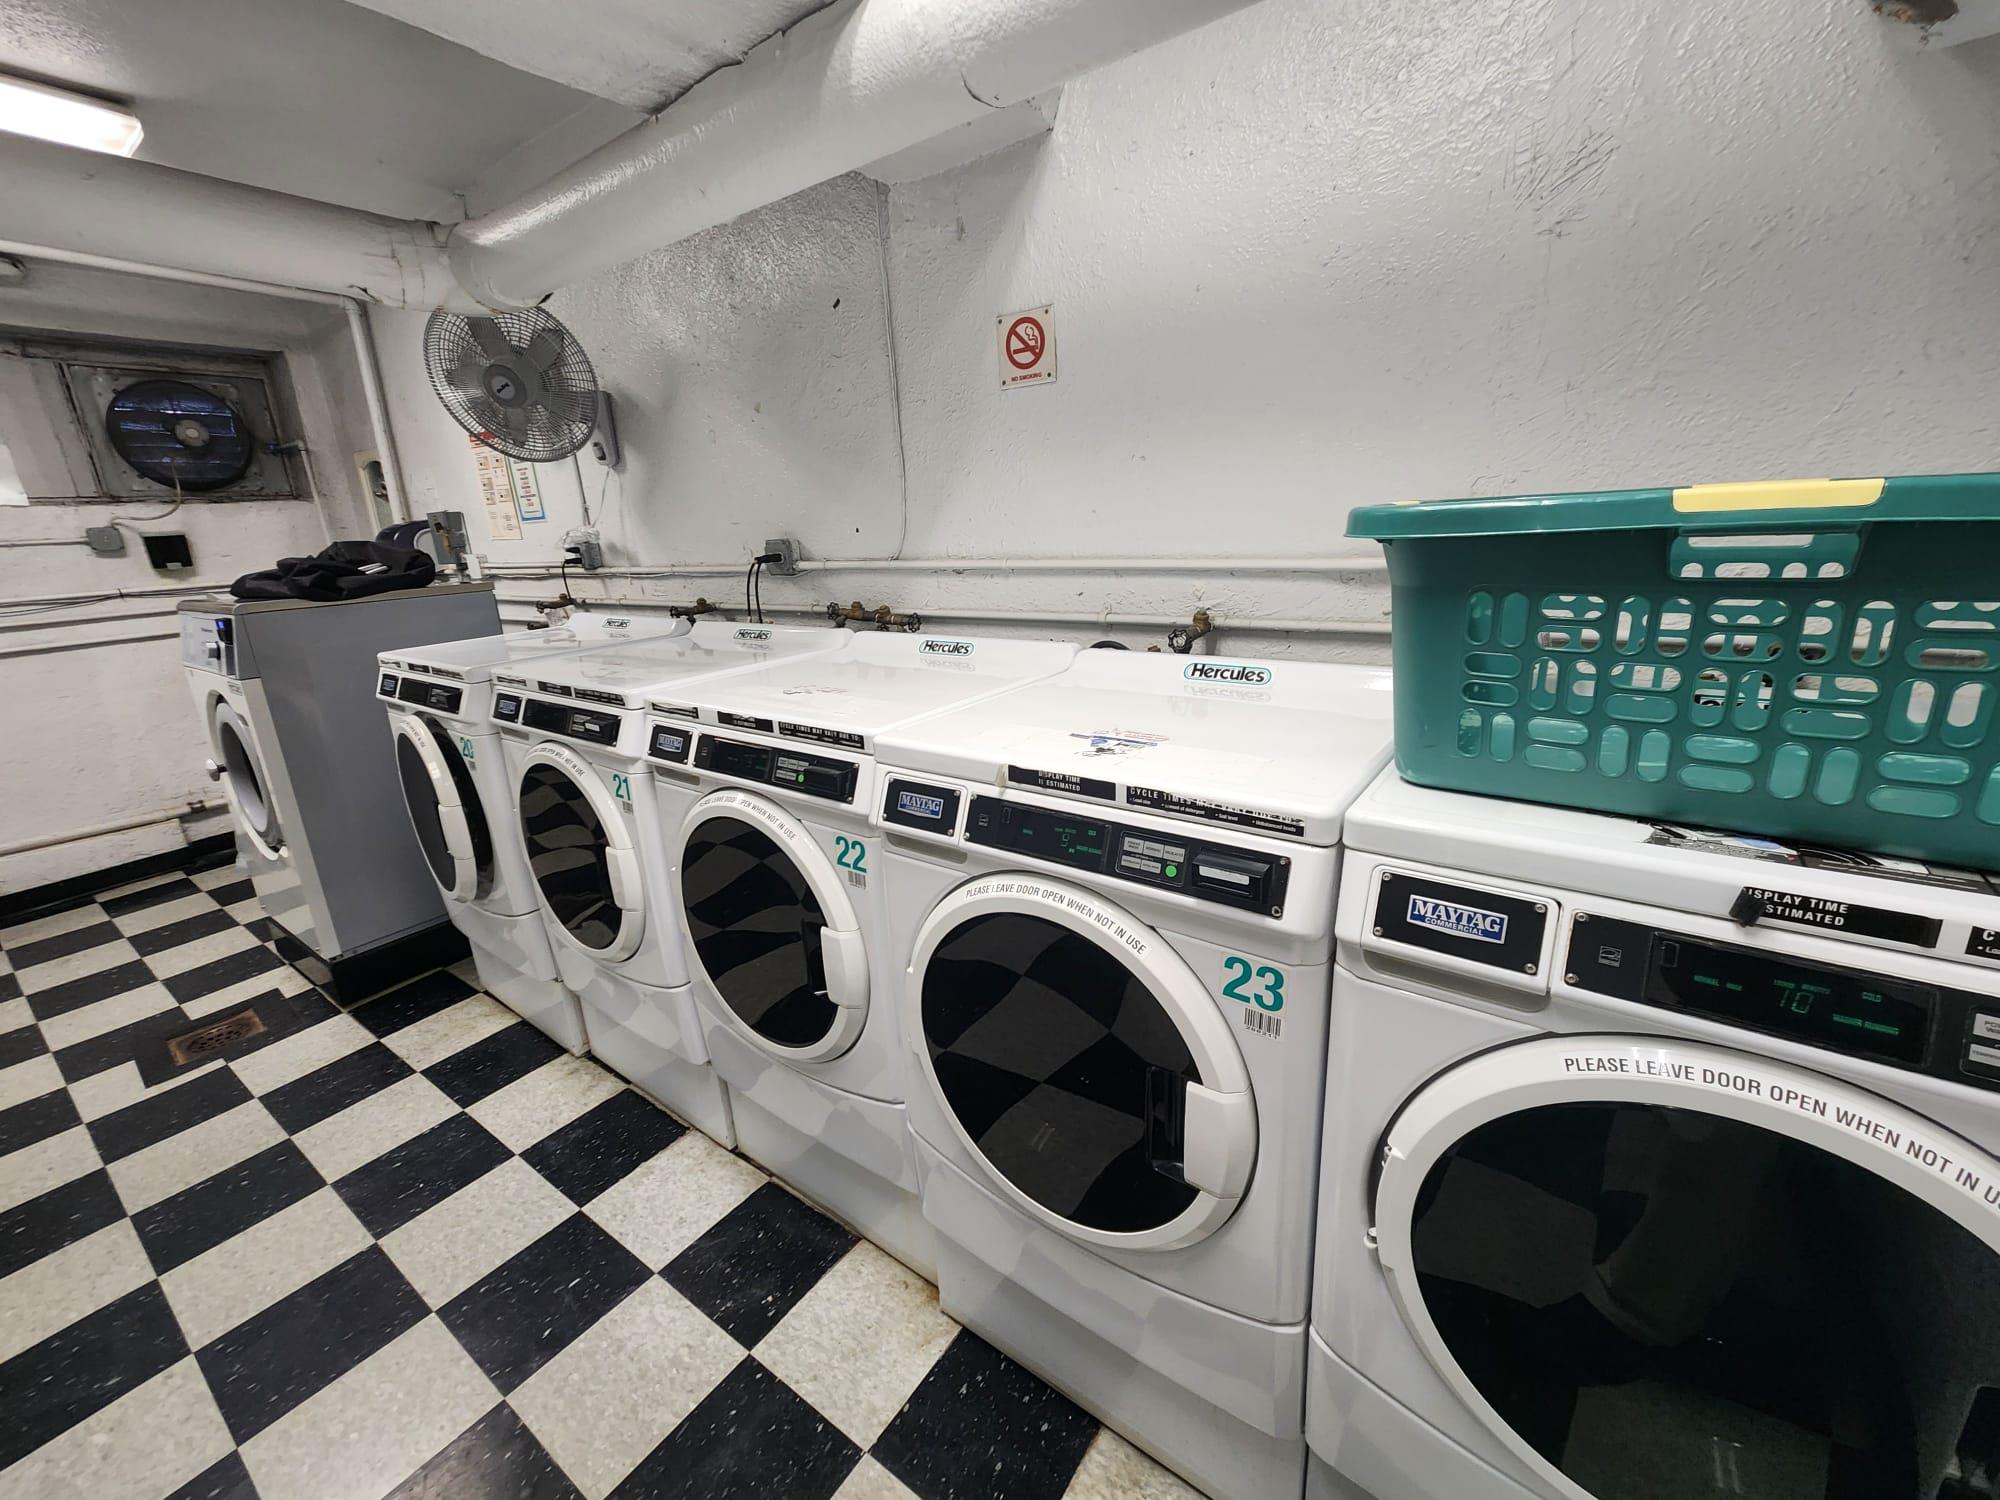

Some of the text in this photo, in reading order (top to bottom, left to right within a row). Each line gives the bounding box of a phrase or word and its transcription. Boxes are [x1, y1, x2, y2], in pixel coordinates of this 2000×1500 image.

[923, 640, 970, 654] Hercules
[1191, 663, 1265, 682] Hercules
[460, 737, 474, 759] 20
[613, 774, 630, 800] 21
[1046, 780, 1080, 791] ESTIMATED
[1065, 775, 1080, 783] TIME
[901, 794, 940, 811] MAYTAG
[1130, 787, 1159, 798] CYCLE
[768, 811, 779, 825] NOT
[777, 820, 785, 830] IN
[784, 827, 797, 840] USE
[836, 836, 866, 873] 22
[1743, 887, 1849, 914] ISPLAY TIME
[966, 883, 1147, 954] PLEASE LEAVE DOOR OPEN WHEN NOT IN USE
[1413, 900, 1502, 932] MAYTAG
[1425, 917, 1484, 936] COMMERCIAL
[1223, 956, 1284, 1012] 23
[1564, 1057, 1629, 1073] PLEASE
[1635, 1059, 1695, 1081] LEAVE
[1702, 1069, 1761, 1096] DOOR
[1769, 1085, 1828, 1117] OPEN
[1835, 1106, 1901, 1148] WHEN
[1905, 1139, 1953, 1173] NOT
[1955, 1167, 1980, 1191] IN
